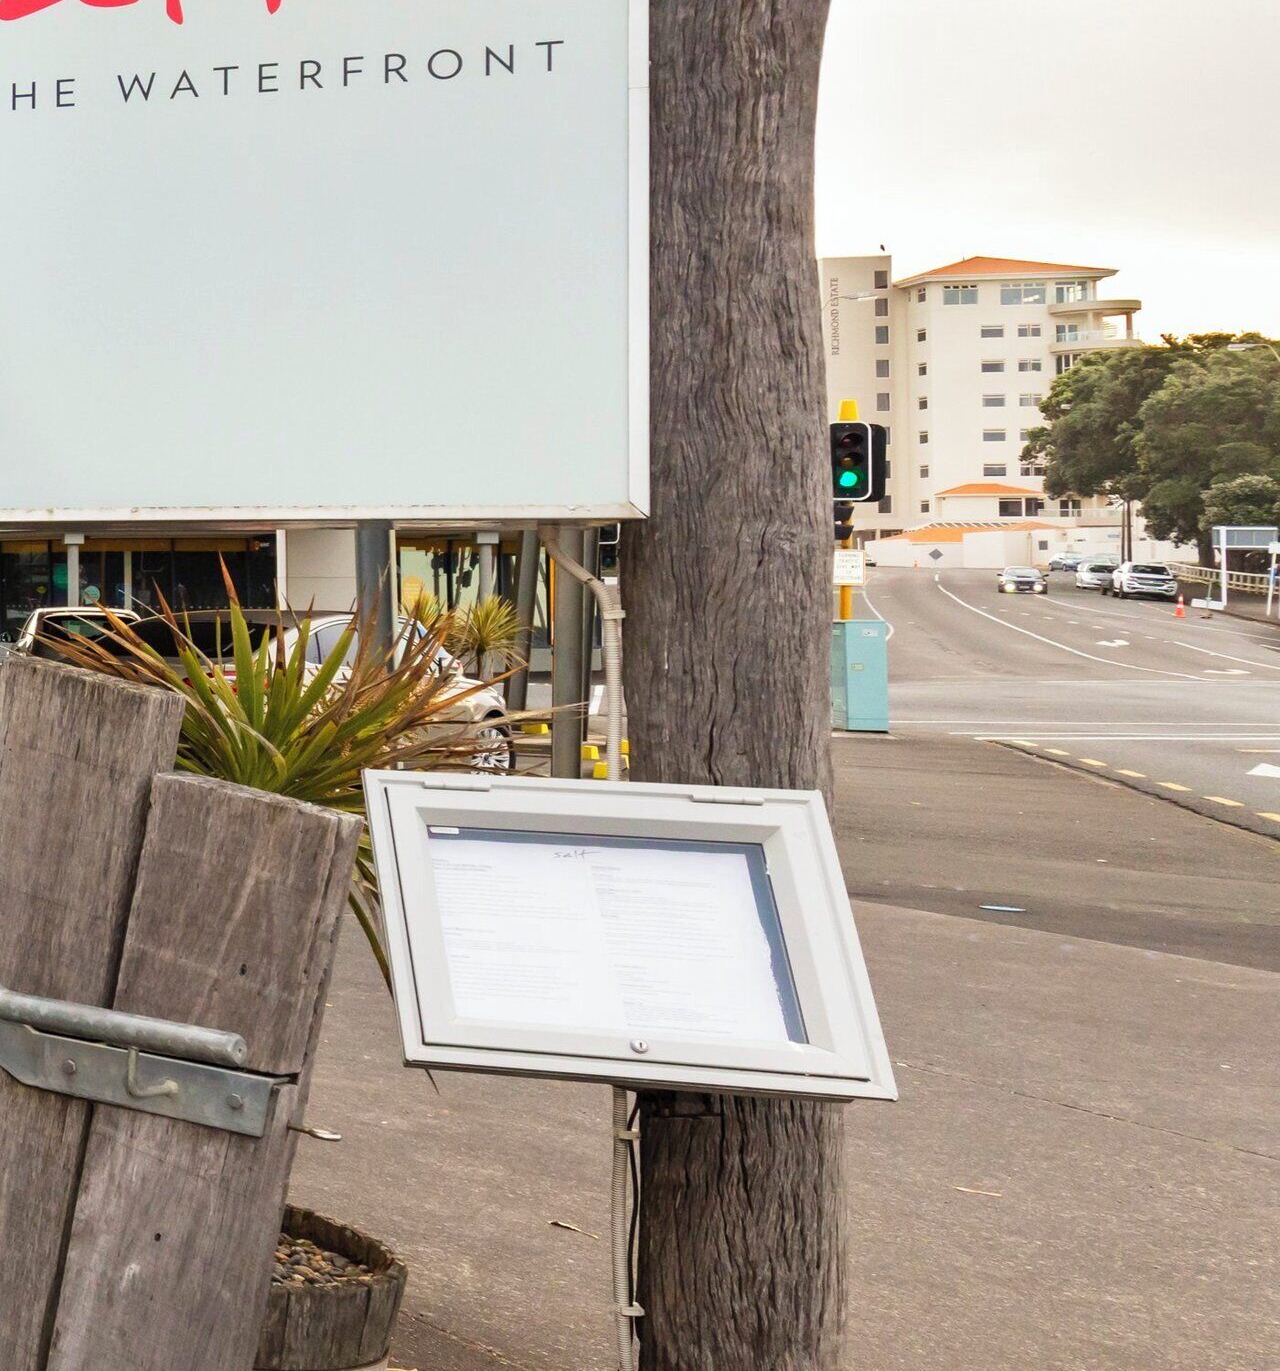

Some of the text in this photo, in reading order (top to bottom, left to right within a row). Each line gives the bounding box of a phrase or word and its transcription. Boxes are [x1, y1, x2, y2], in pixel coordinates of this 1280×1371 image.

[117, 40, 566, 103] WATERFRONT
[829, 277, 840, 356] RICHMOND ESTATE
[553, 849, 603, 860] salt
